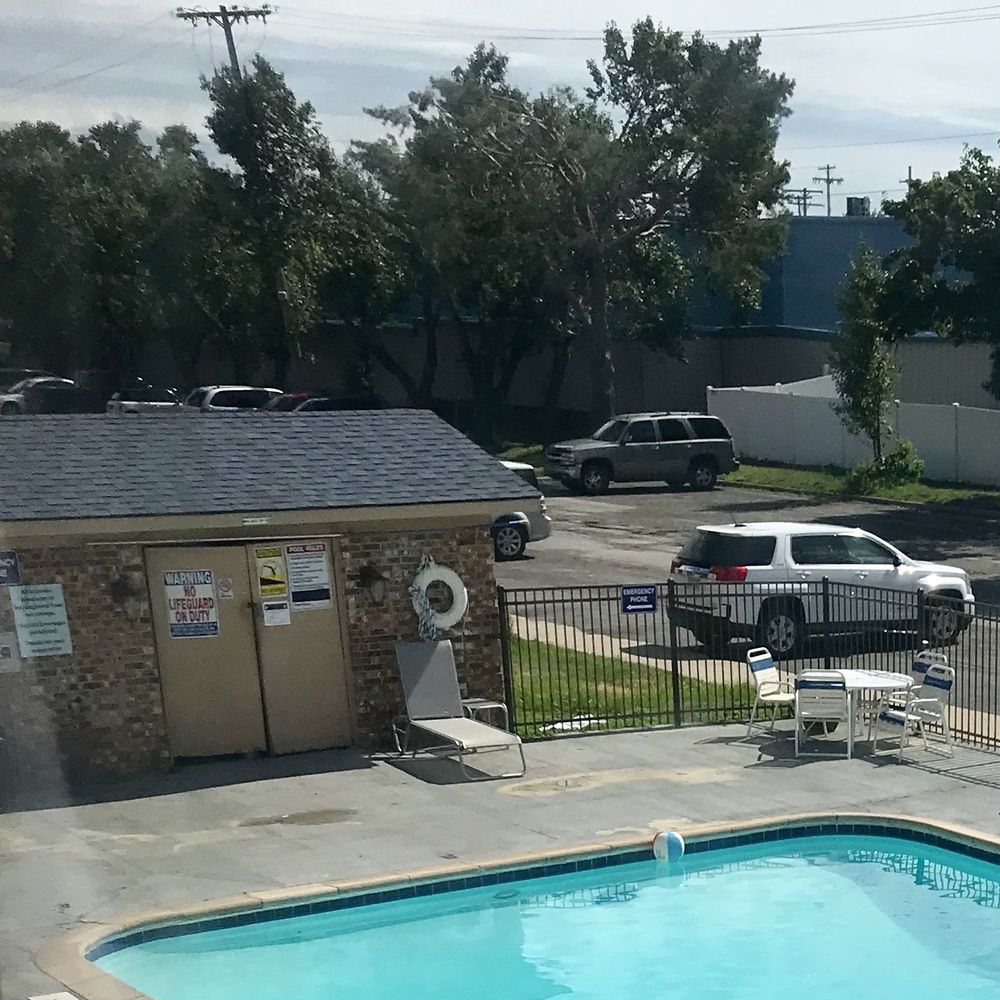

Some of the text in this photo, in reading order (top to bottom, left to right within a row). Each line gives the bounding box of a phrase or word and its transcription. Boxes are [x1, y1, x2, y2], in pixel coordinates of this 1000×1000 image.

[165, 571, 212, 584] WARNING
[184, 585, 196, 597] NO
[623, 588, 654, 596] EMERGENCY
[168, 597, 214, 610] LIFEGUARD
[175, 610, 210, 622] ON DUTY
